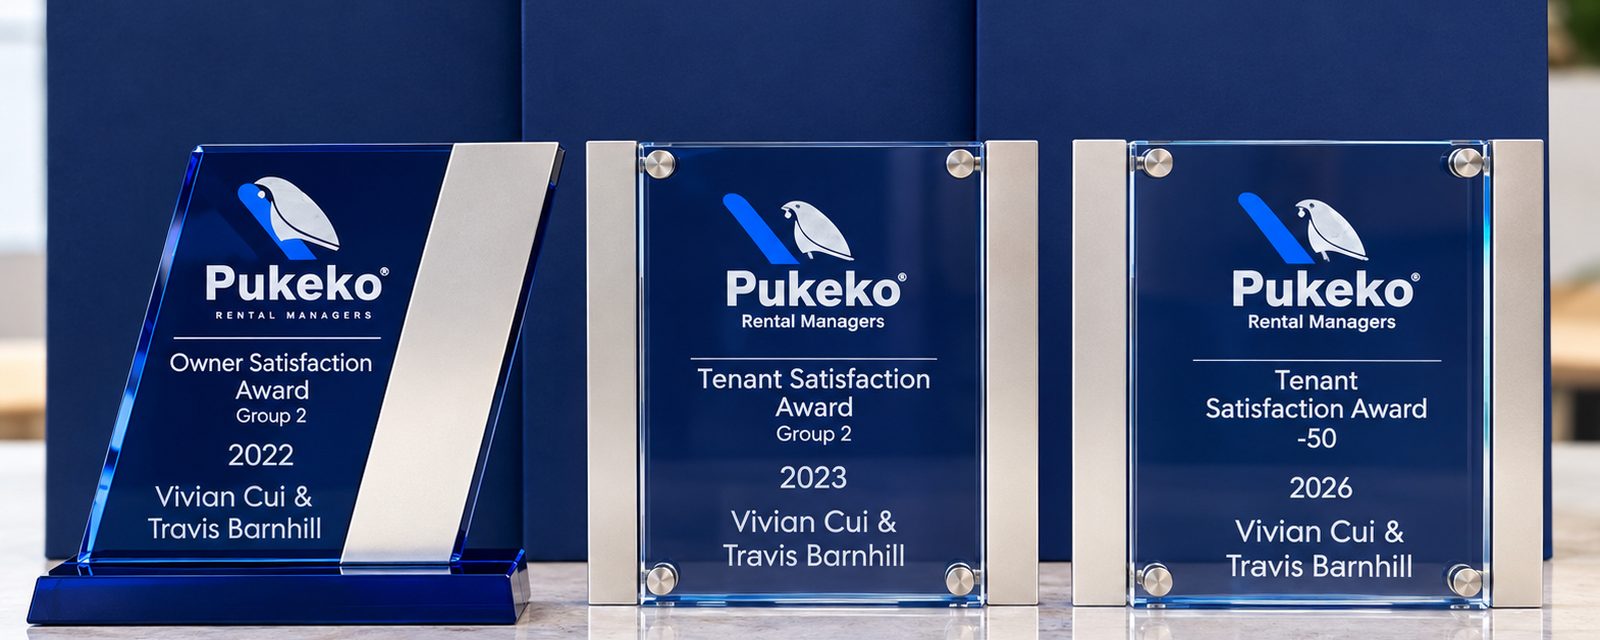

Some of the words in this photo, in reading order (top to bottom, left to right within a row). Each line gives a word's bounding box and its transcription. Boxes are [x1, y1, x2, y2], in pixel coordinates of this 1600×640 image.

[215, 311, 276, 320] RENTAL
[286, 310, 372, 320] MANAGERS
[742, 313, 796, 329] Rental
[800, 313, 885, 332] Managers
[1248, 313, 1304, 329] Rental
[1309, 314, 1397, 333] Managers
[169, 352, 244, 372] Owner
[249, 352, 372, 373] Satisfaction
[235, 379, 309, 400] Award
[697, 367, 783, 390] Tenant
[789, 367, 930, 390] Satisfaction
[1274, 369, 1359, 391] Tenant
[236, 407, 291, 427] Group
[296, 407, 307, 423] 2
[775, 395, 853, 418] Award
[1205, 397, 1344, 419] Satisfaction
[1350, 397, 1427, 419] Award
[776, 425, 836, 446] Group
[840, 424, 852, 442] 2
[1297, 427, 1337, 449] -50
[228, 443, 294, 467] 2022
[780, 465, 847, 489] 2023
[1289, 476, 1353, 499] 2026
[155, 485, 235, 508] Vivian
[243, 485, 285, 508] Cui
[294, 485, 313, 508] &
[147, 517, 220, 540] Travis
[228, 516, 321, 539] Barnhill
[730, 509, 815, 533] Vivian
[824, 509, 868, 533] Cui
[877, 509, 897, 533] &
[1234, 518, 1321, 543] Vivian
[1330, 519, 1375, 544] Cui
[1384, 519, 1405, 544] &
[722, 543, 798, 567] Travis
[807, 543, 905, 567] Barnhill
[1225, 553, 1304, 578] Travis
[1312, 553, 1412, 578] Barnhill
